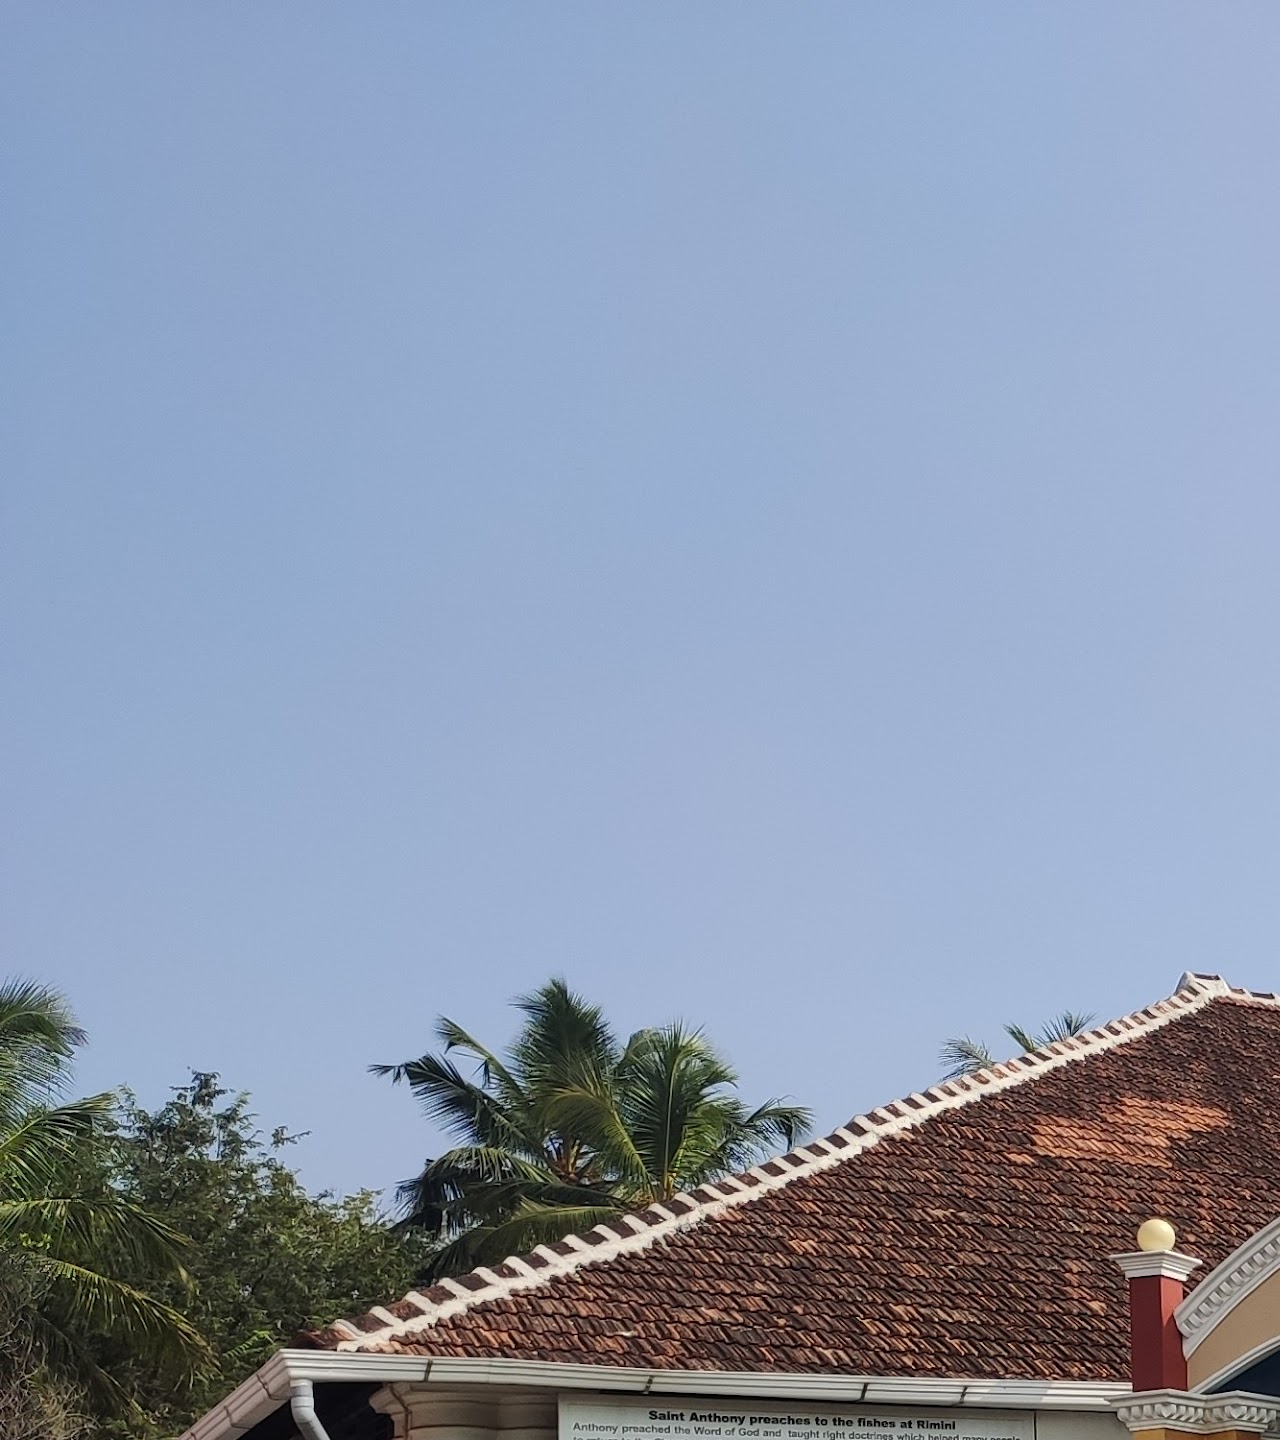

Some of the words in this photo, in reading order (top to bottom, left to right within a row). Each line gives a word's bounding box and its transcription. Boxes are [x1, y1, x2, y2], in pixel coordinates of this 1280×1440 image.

[648, 1410, 685, 1421] Saint
[688, 1411, 745, 1425] Anthony
[749, 1414, 810, 1427] preaches
[814, 1417, 828, 1426] to
[831, 1416, 853, 1427] the
[857, 1417, 896, 1428] fishes
[899, 1420, 912, 1429] at
[916, 1419, 955, 1430] Rimini
[572, 1422, 618, 1434] Anthony
[621, 1423, 670, 1436] preached
[674, 1425, 690, 1434] the
[693, 1426, 721, 1435] Word
[724, 1427, 735, 1436] of
[737, 1427, 759, 1436] God
[762, 1428, 781, 1437] and
[787, 1429, 819, 1440] taught
[822, 1430, 845, 1440] right
[848, 1431, 893, 1440] doctrines
[896, 1432, 924, 1440] which
